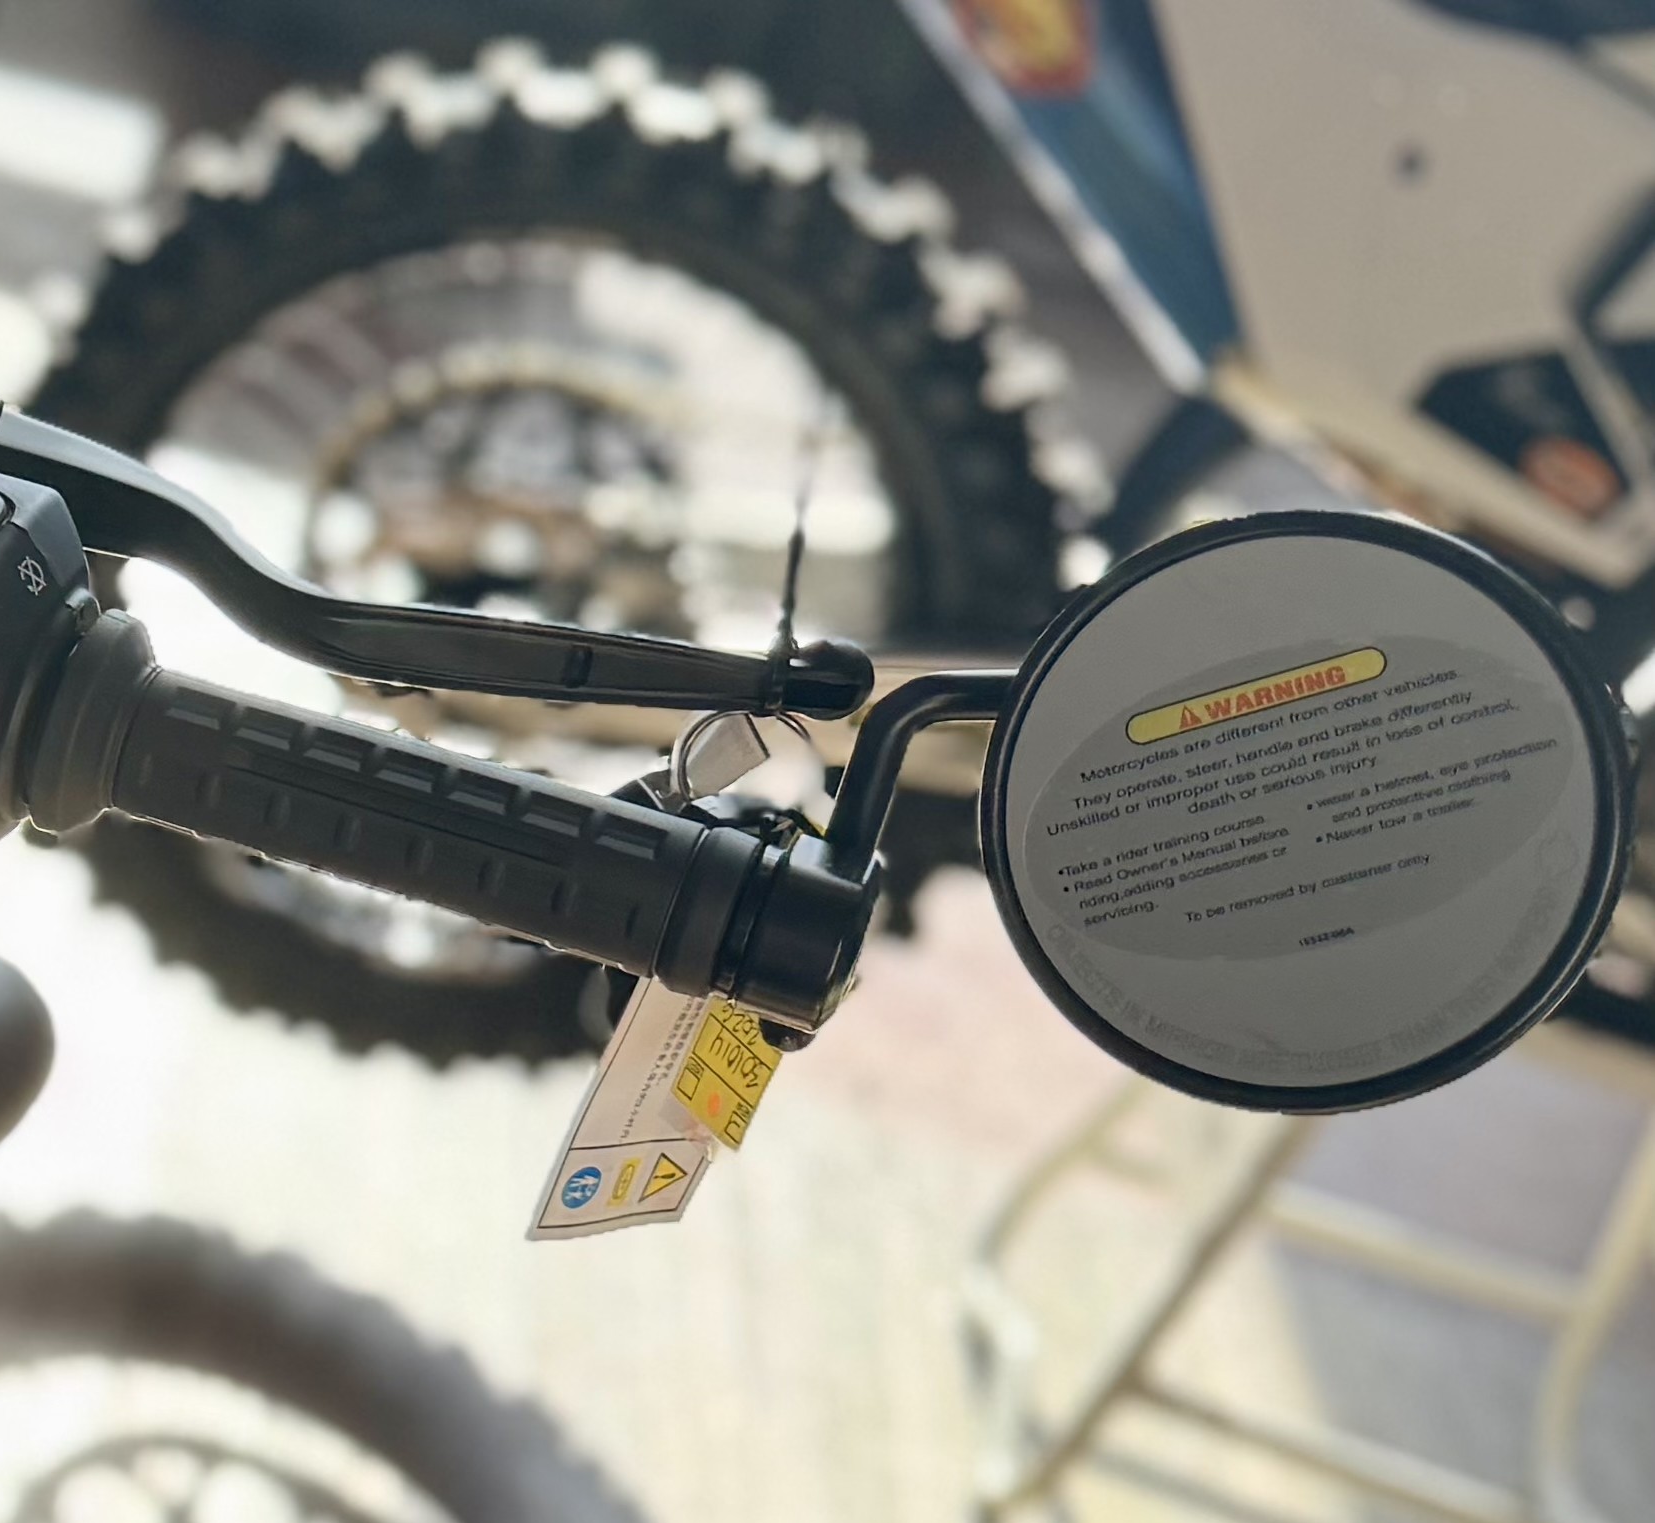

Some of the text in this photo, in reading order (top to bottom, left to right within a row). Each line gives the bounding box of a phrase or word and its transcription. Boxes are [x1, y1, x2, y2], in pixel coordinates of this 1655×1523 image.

[1204, 665, 1347, 720] WARNING
[1072, 792, 1111, 810] They
[1297, 729, 1330, 747] and
[1079, 748, 1179, 783] Motorcycles
[1183, 739, 1211, 754] are
[1215, 716, 1284, 745] different
[1289, 706, 1329, 724] from
[1046, 805, 1120, 836] Unskilled
[1125, 802, 1140, 814] or
[1146, 780, 1219, 809] improper
[1187, 791, 1236, 814] death
[1239, 787, 1257, 800] or
[1116, 845, 1149, 863] rider
[1152, 831, 1210, 853] training
[1271, 846, 1287, 858] or
